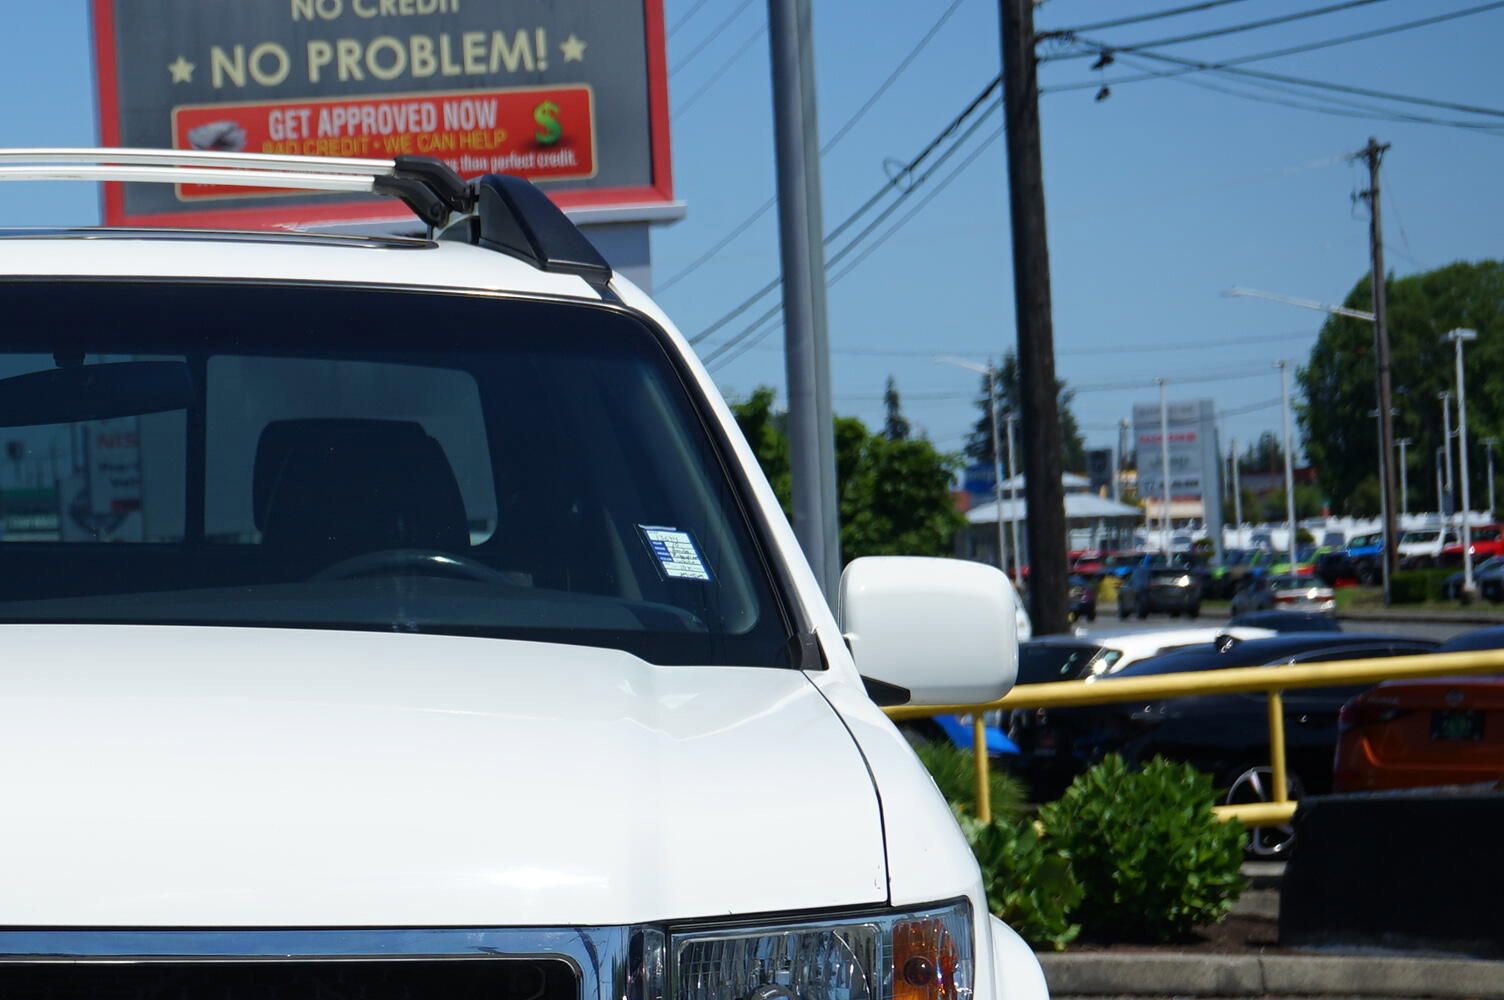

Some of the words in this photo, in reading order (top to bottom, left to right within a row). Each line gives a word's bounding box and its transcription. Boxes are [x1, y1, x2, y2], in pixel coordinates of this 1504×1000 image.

[291, 0, 343, 21] NO
[211, 41, 290, 88] NO
[306, 26, 548, 83] PROBLEM!
[268, 108, 312, 141] GET
[317, 102, 438, 138] APPROVED
[443, 99, 498, 130] NOW
[303, 135, 369, 156] CREDIT
[383, 134, 412, 154] WE
[416, 132, 454, 152] CAN
[459, 127, 508, 149] HELP
[459, 154, 489, 171] than
[490, 151, 534, 173] perfect
[536, 149, 578, 168] credit.
